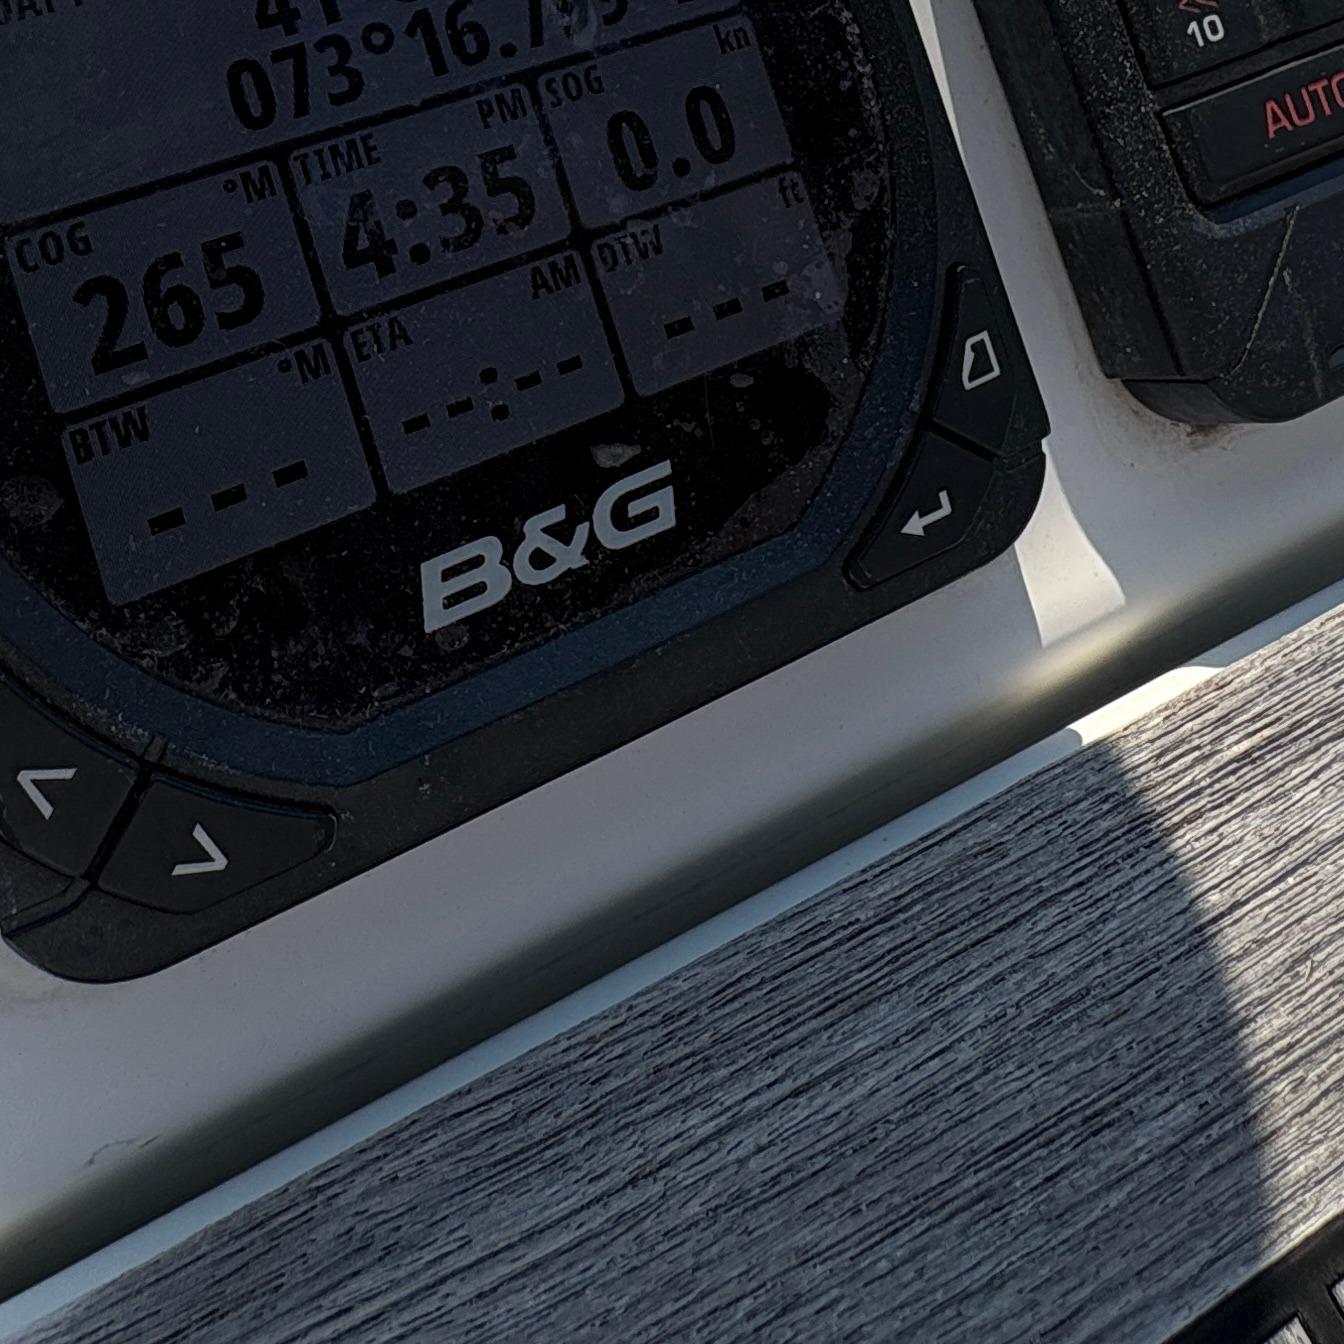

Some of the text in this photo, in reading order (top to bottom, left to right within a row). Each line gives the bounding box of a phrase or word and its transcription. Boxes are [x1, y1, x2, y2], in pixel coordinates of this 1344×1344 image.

[712, 23, 752, 55] kn
[1186, 13, 1226, 48] 10
[475, 87, 528, 129] PM
[545, 64, 605, 109] SOG
[292, 132, 381, 185] TIME
[606, 85, 736, 192] 0.0
[341, 144, 537, 280] 4:35
[776, 173, 805, 209] ft
[14, 220, 94, 274] COG
[596, 224, 664, 273] DTW
[528, 252, 582, 299] AM
[72, 231, 265, 376] 265
[349, 317, 413, 362] ETA
[420, 459, 677, 634] B&G
